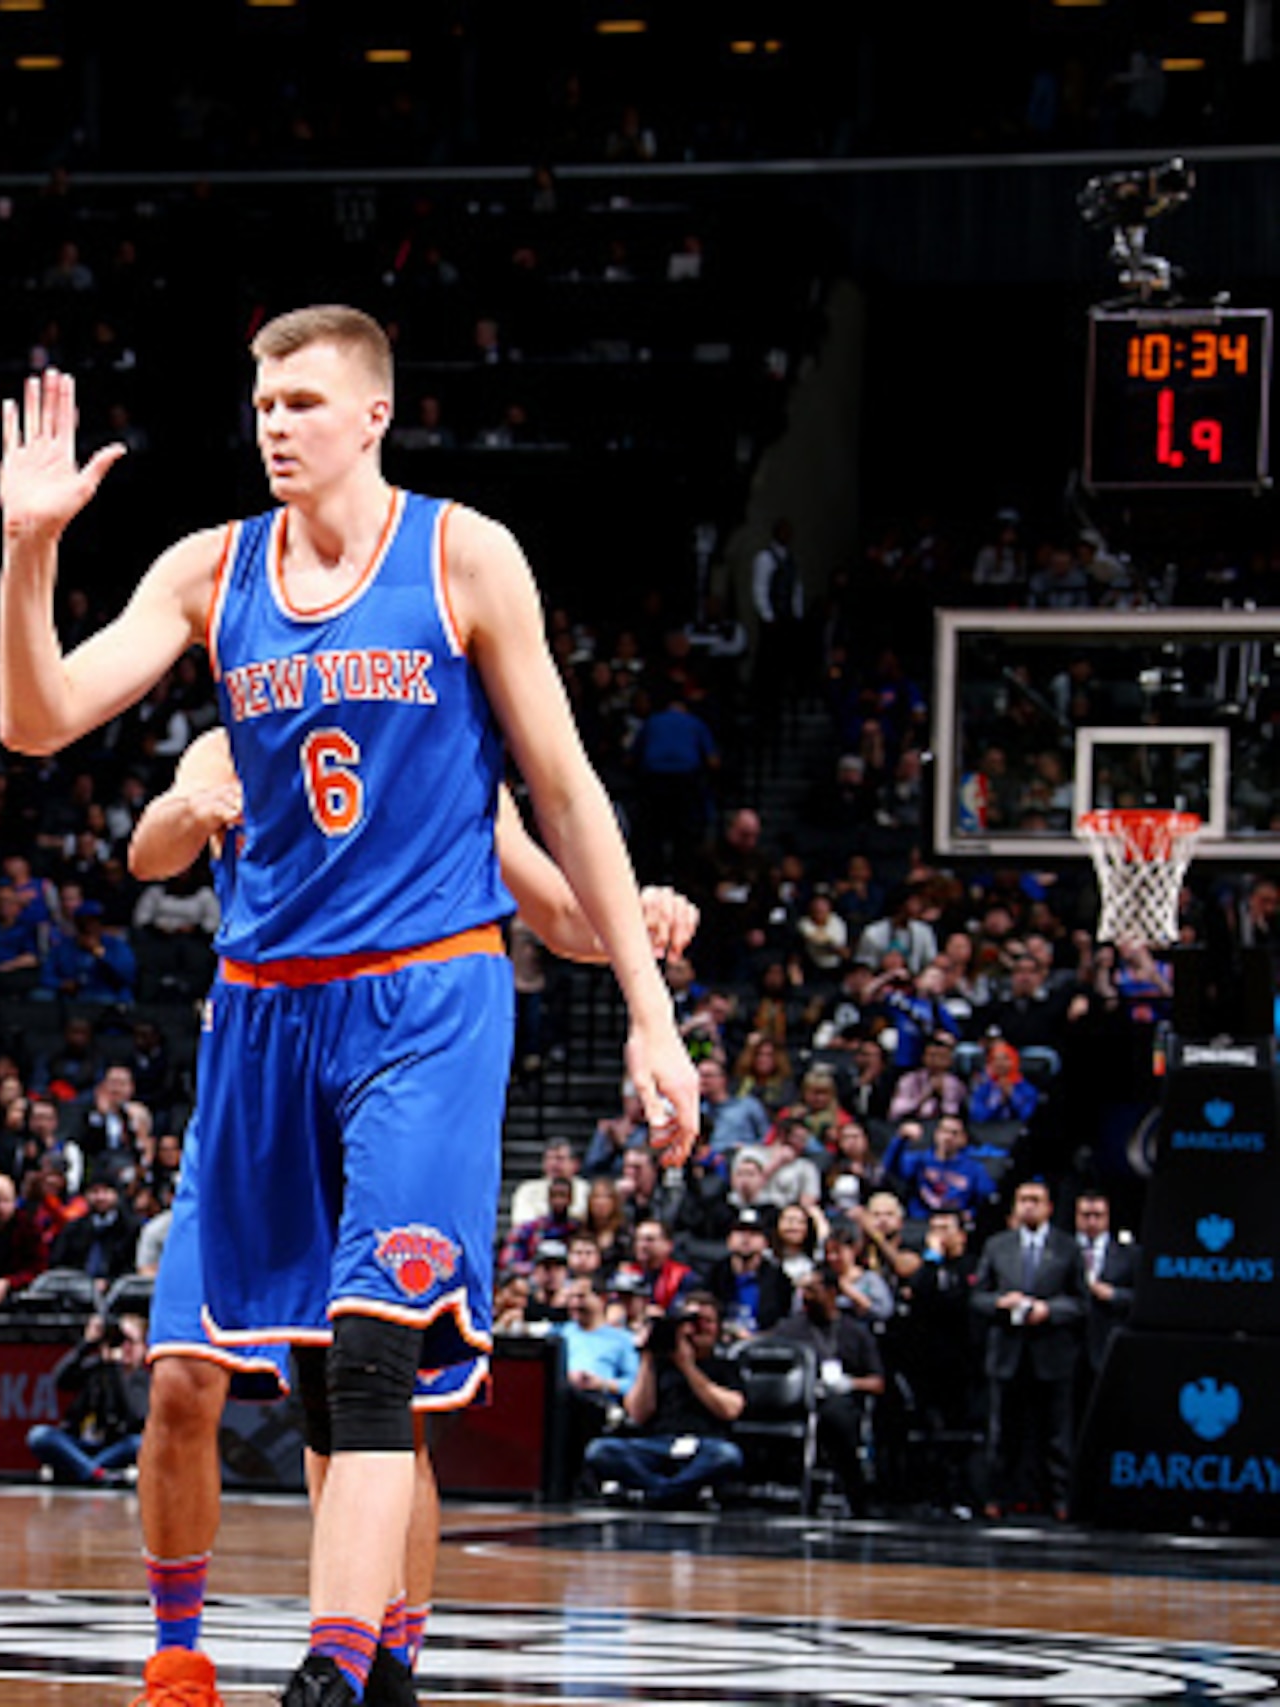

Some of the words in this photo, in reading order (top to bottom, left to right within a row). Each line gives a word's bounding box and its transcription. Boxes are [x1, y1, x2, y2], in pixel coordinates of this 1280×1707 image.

[1127, 331, 1248, 380] 10:34
[225, 654, 307, 722] NEW
[313, 650, 437, 704] YORK
[300, 728, 363, 836] 6
[1154, 1256, 1273, 1282] BARCLAYS
